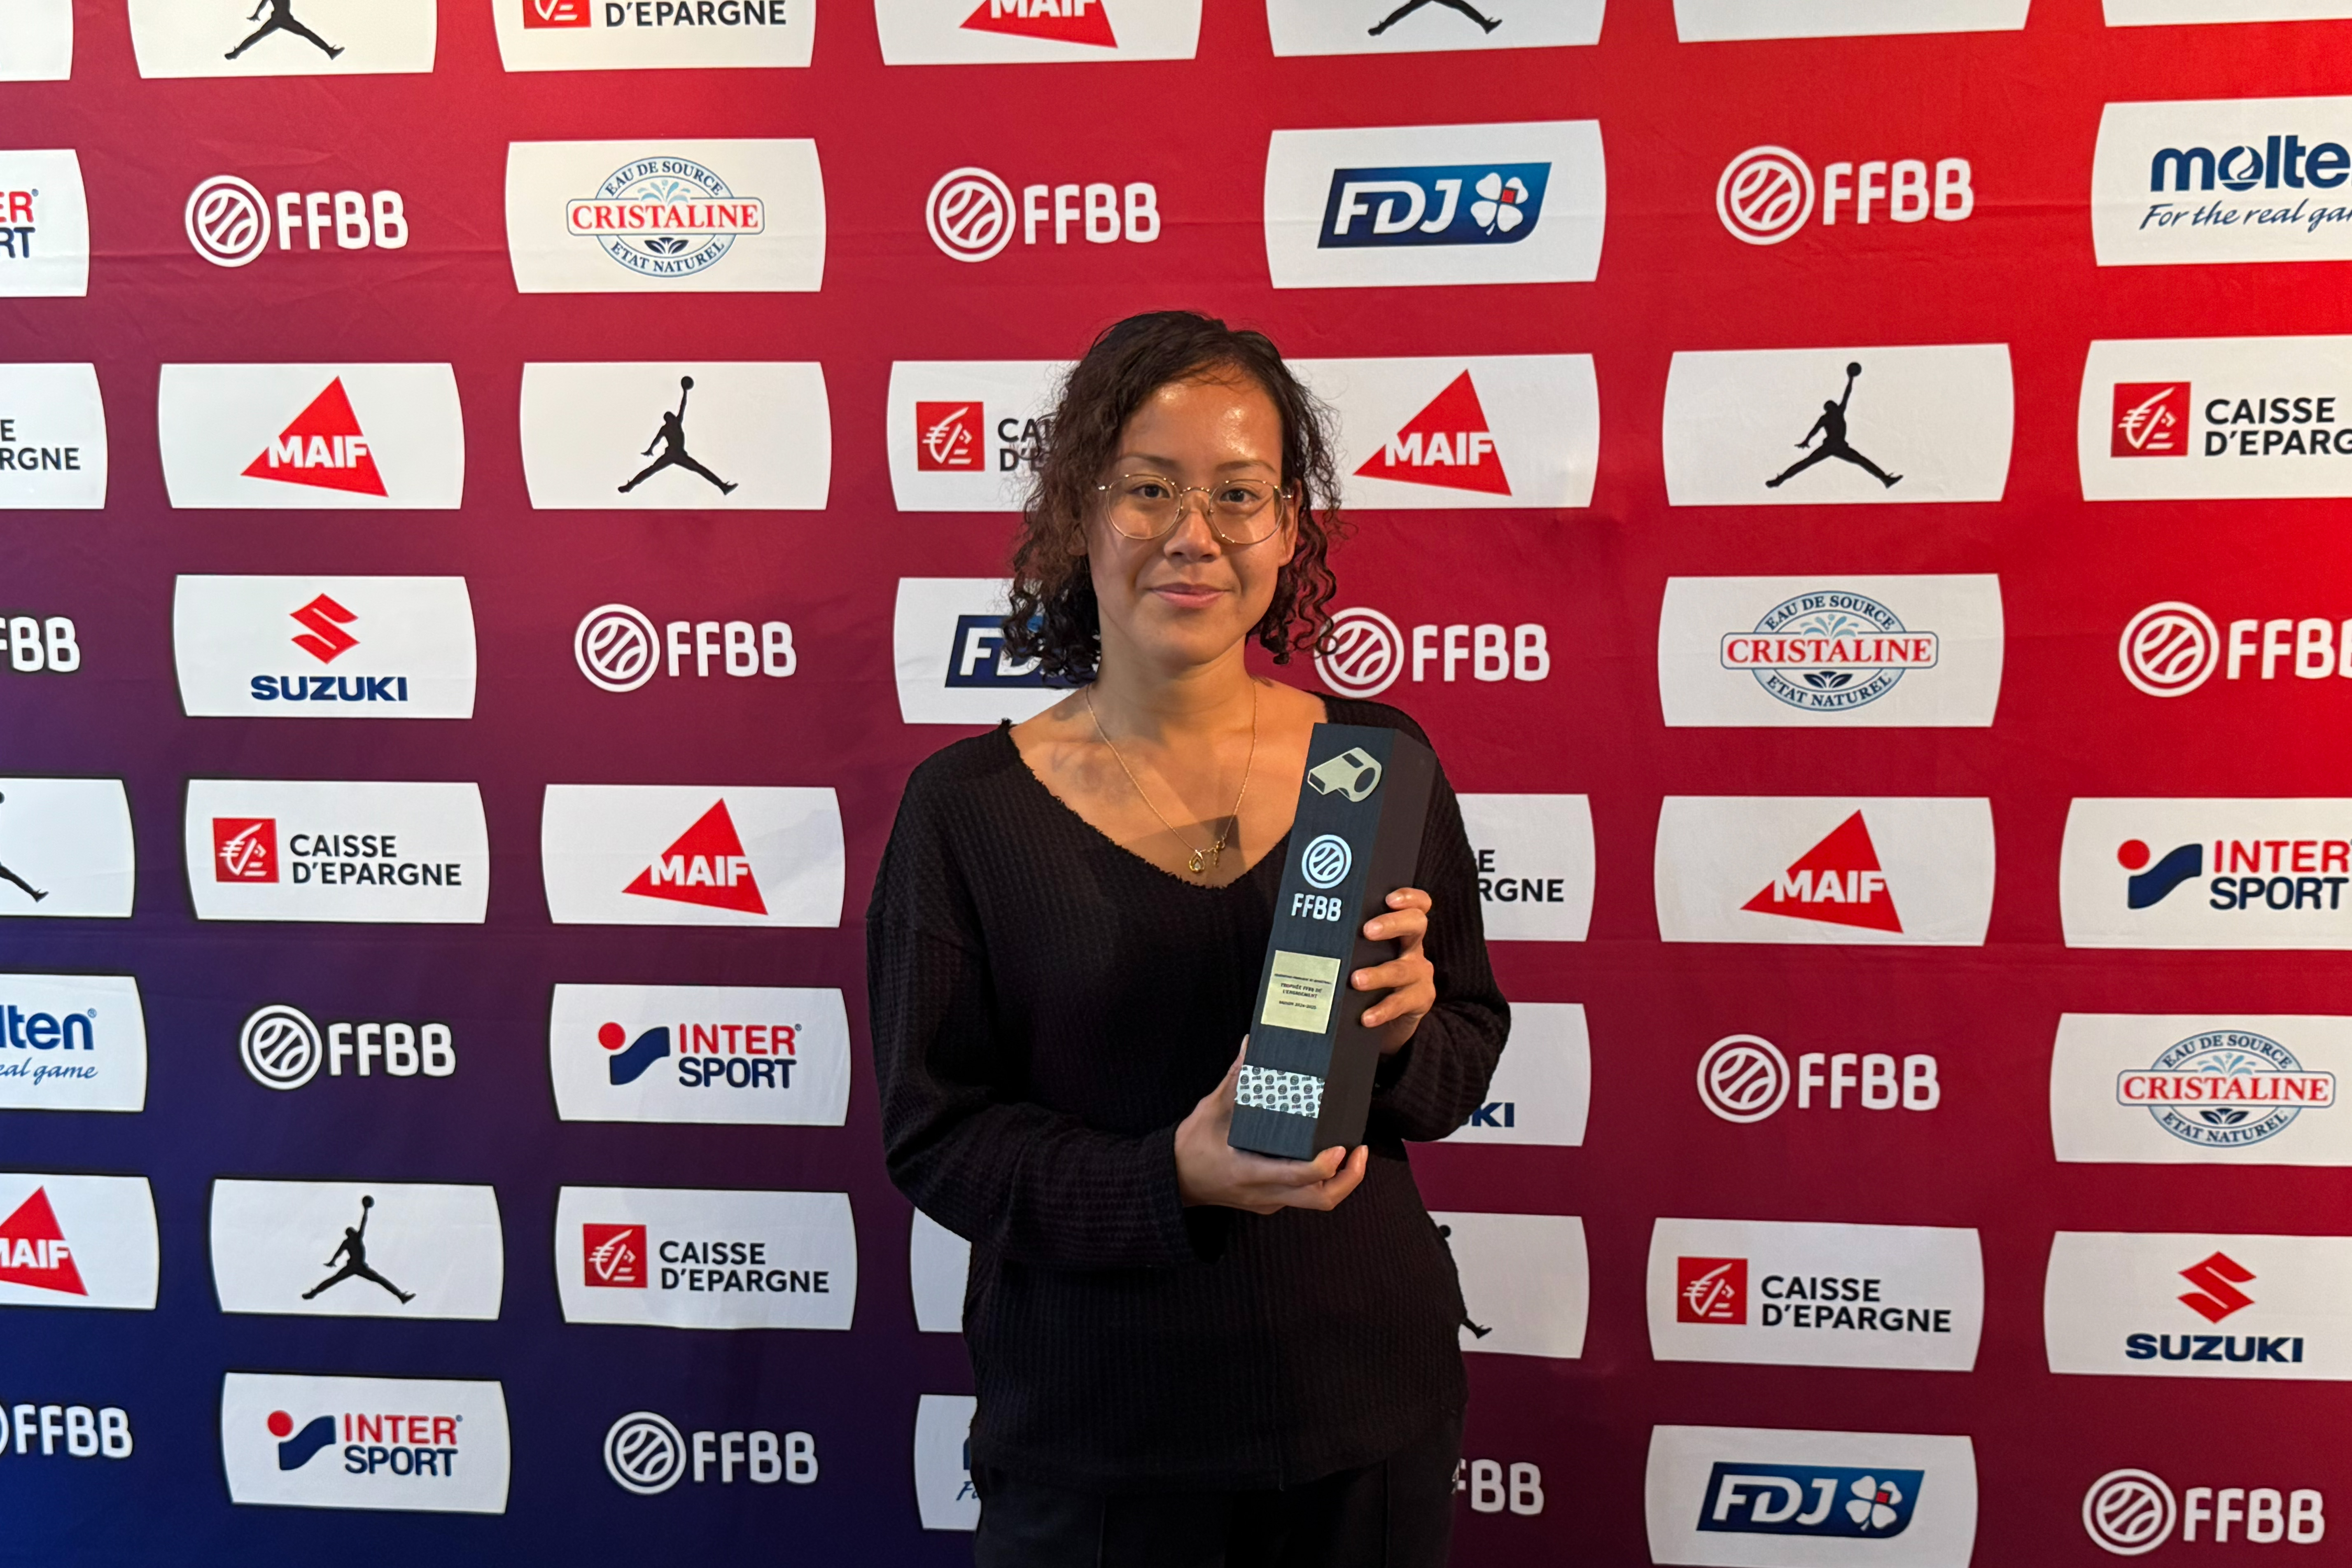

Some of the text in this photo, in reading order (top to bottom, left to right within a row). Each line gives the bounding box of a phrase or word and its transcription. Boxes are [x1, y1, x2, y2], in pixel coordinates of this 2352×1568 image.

[606, 0, 786, 27] D'EPARGNE
[605, 161, 723, 196] EAU DE SOURCE
[1823, 158, 1974, 225] FFBB
[277, 191, 408, 250] FFBB
[573, 205, 758, 229] CRISTALINE
[1024, 183, 1160, 244] FFBB
[1334, 179, 1462, 235] FDJ
[2139, 203, 2186, 230] For
[2192, 200, 2242, 226] the
[2243, 198, 2309, 225] real
[611, 241, 725, 273] ETAT NATUREL
[2205, 397, 2335, 425] CAISSE
[268, 435, 368, 468] MAIF
[1385, 432, 1492, 466] MAIF
[1765, 595, 1895, 630] EAU DE SOURCE
[667, 621, 796, 677] FFBB
[1413, 624, 1549, 681] FFBB
[1728, 639, 1930, 662] CRISTALINE
[251, 676, 407, 701] SUZUKI
[1766, 674, 1892, 707] ETAT NATUREL
[290, 834, 396, 857] CAISSE
[2214, 840, 2350, 873] INTER
[293, 862, 461, 885] D'EPARGNE
[651, 855, 749, 886] MAIF
[1773, 870, 1885, 902] MAIF
[1292, 894, 1341, 921] FFBB
[2210, 877, 2349, 910] SPORT
[329, 1023, 455, 1076] FFBB
[679, 1023, 796, 1055] INTER
[2163, 1035, 2292, 1069] EAU DE SOURCE
[33, 1066, 98, 1085] game
[679, 1057, 797, 1088] SPORT
[1799, 1053, 1940, 1111] FFBB
[2124, 1077, 2328, 1100] CRISTALINE
[2161, 1112, 2287, 1143] ETAT NATUREL
[660, 1241, 765, 1265] CAISSE
[662, 1268, 829, 1293] D'EPARGNE
[1761, 1276, 1881, 1302] CAISSE
[1762, 1304, 1951, 1332] D'EPARGNE
[2126, 1334, 2303, 1362] SUZUKI
[14, 1405, 132, 1458] FFBB
[344, 1413, 458, 1445] INTER
[345, 1445, 458, 1477] SPORT
[693, 1431, 818, 1483] FFBB
[1712, 1475, 1839, 1526] FDJ
[2184, 1488, 2324, 1543] FFBB
